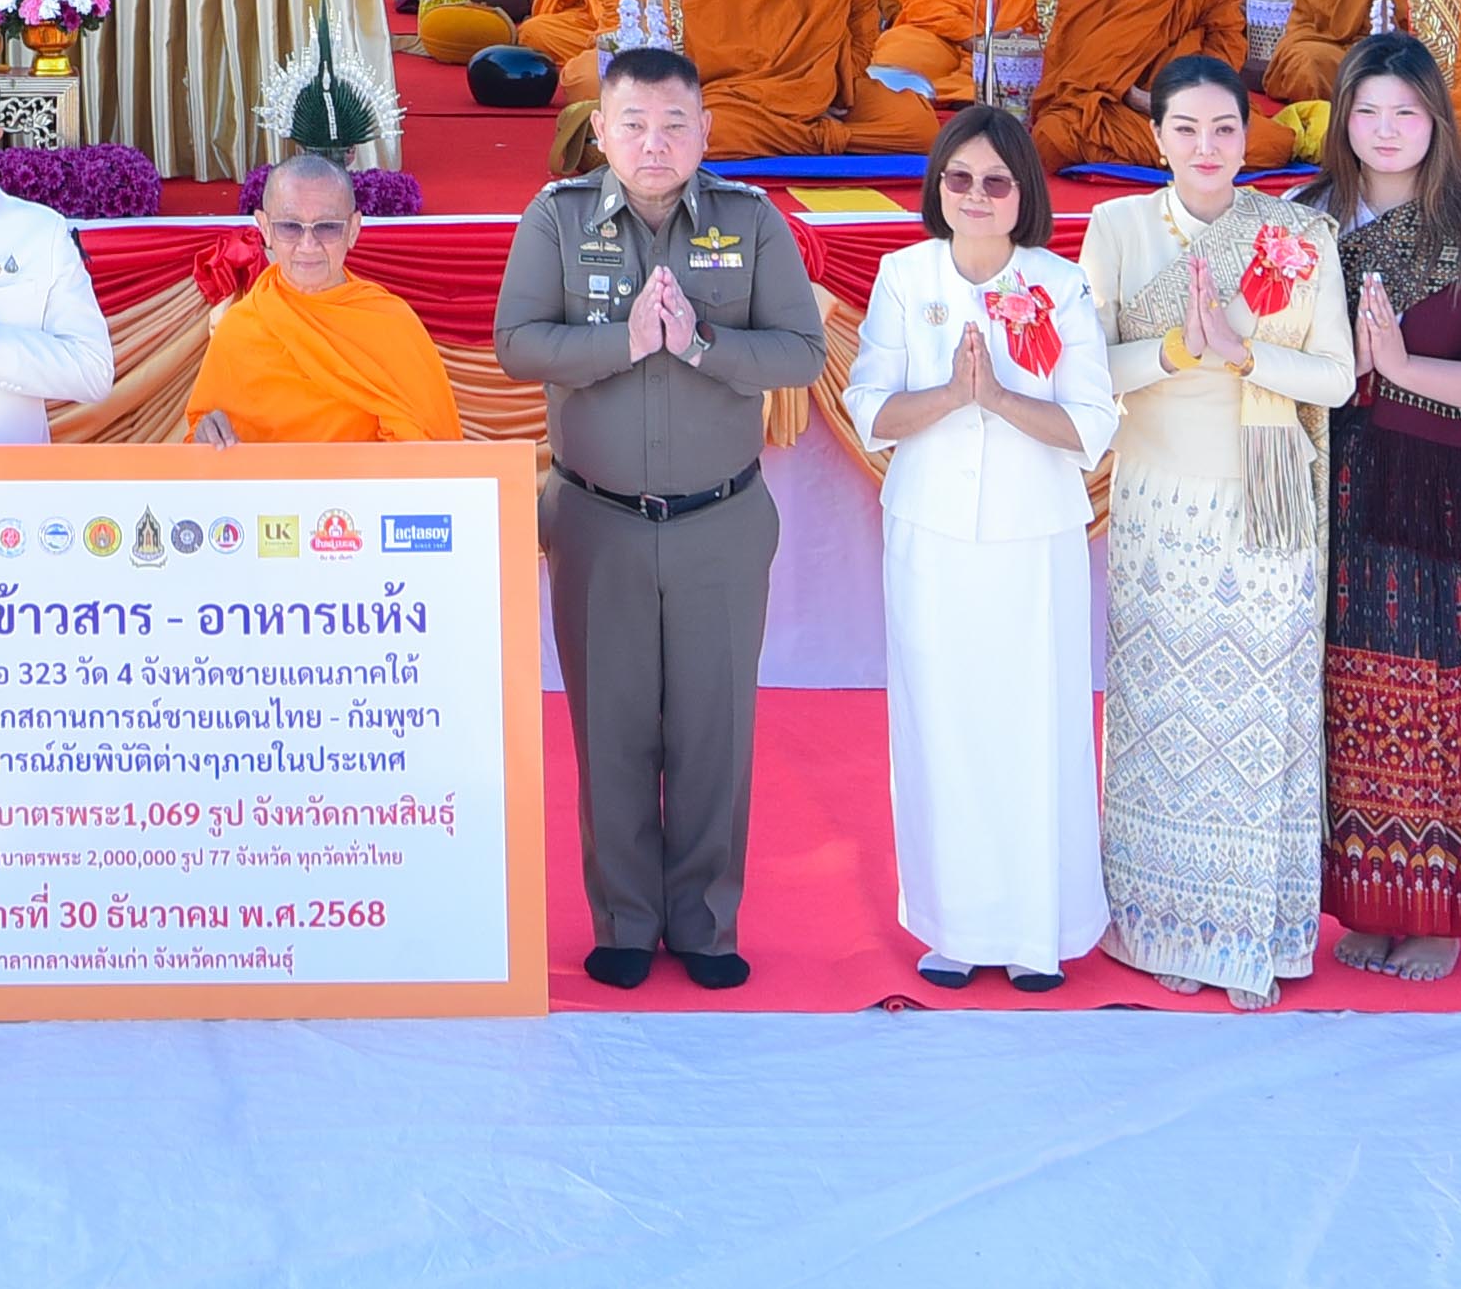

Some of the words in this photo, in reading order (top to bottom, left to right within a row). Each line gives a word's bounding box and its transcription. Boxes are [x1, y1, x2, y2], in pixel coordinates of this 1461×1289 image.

[265, 523, 292, 540] UK
[384, 518, 449, 549] Lactasoy
[197, 581, 426, 636] อาหารแห้ง
[19, 662, 67, 685] 323
[75, 655, 108, 685] วัด
[117, 662, 133, 685] 4
[141, 652, 420, 686] จังหวัดชายแดนภาคใต้
[348, 698, 440, 738] กัมพูชา
[208, 798, 243, 837] รูป
[252, 792, 455, 836] จังหวัดกาฬสินธุ์
[87, 850, 176, 869] 2,000,000
[181, 847, 203, 873] รูป
[209, 850, 230, 866] 77
[236, 845, 292, 866] จังหวัด
[297, 843, 403, 873] ทุกวัดทั่วไทย
[60, 901, 97, 929] 30
[107, 893, 228, 928] ธันวาคม
[238, 900, 386, 928] พ.ศ.2568
[153, 945, 293, 976] จังหวัดกาฬสินธุ์
